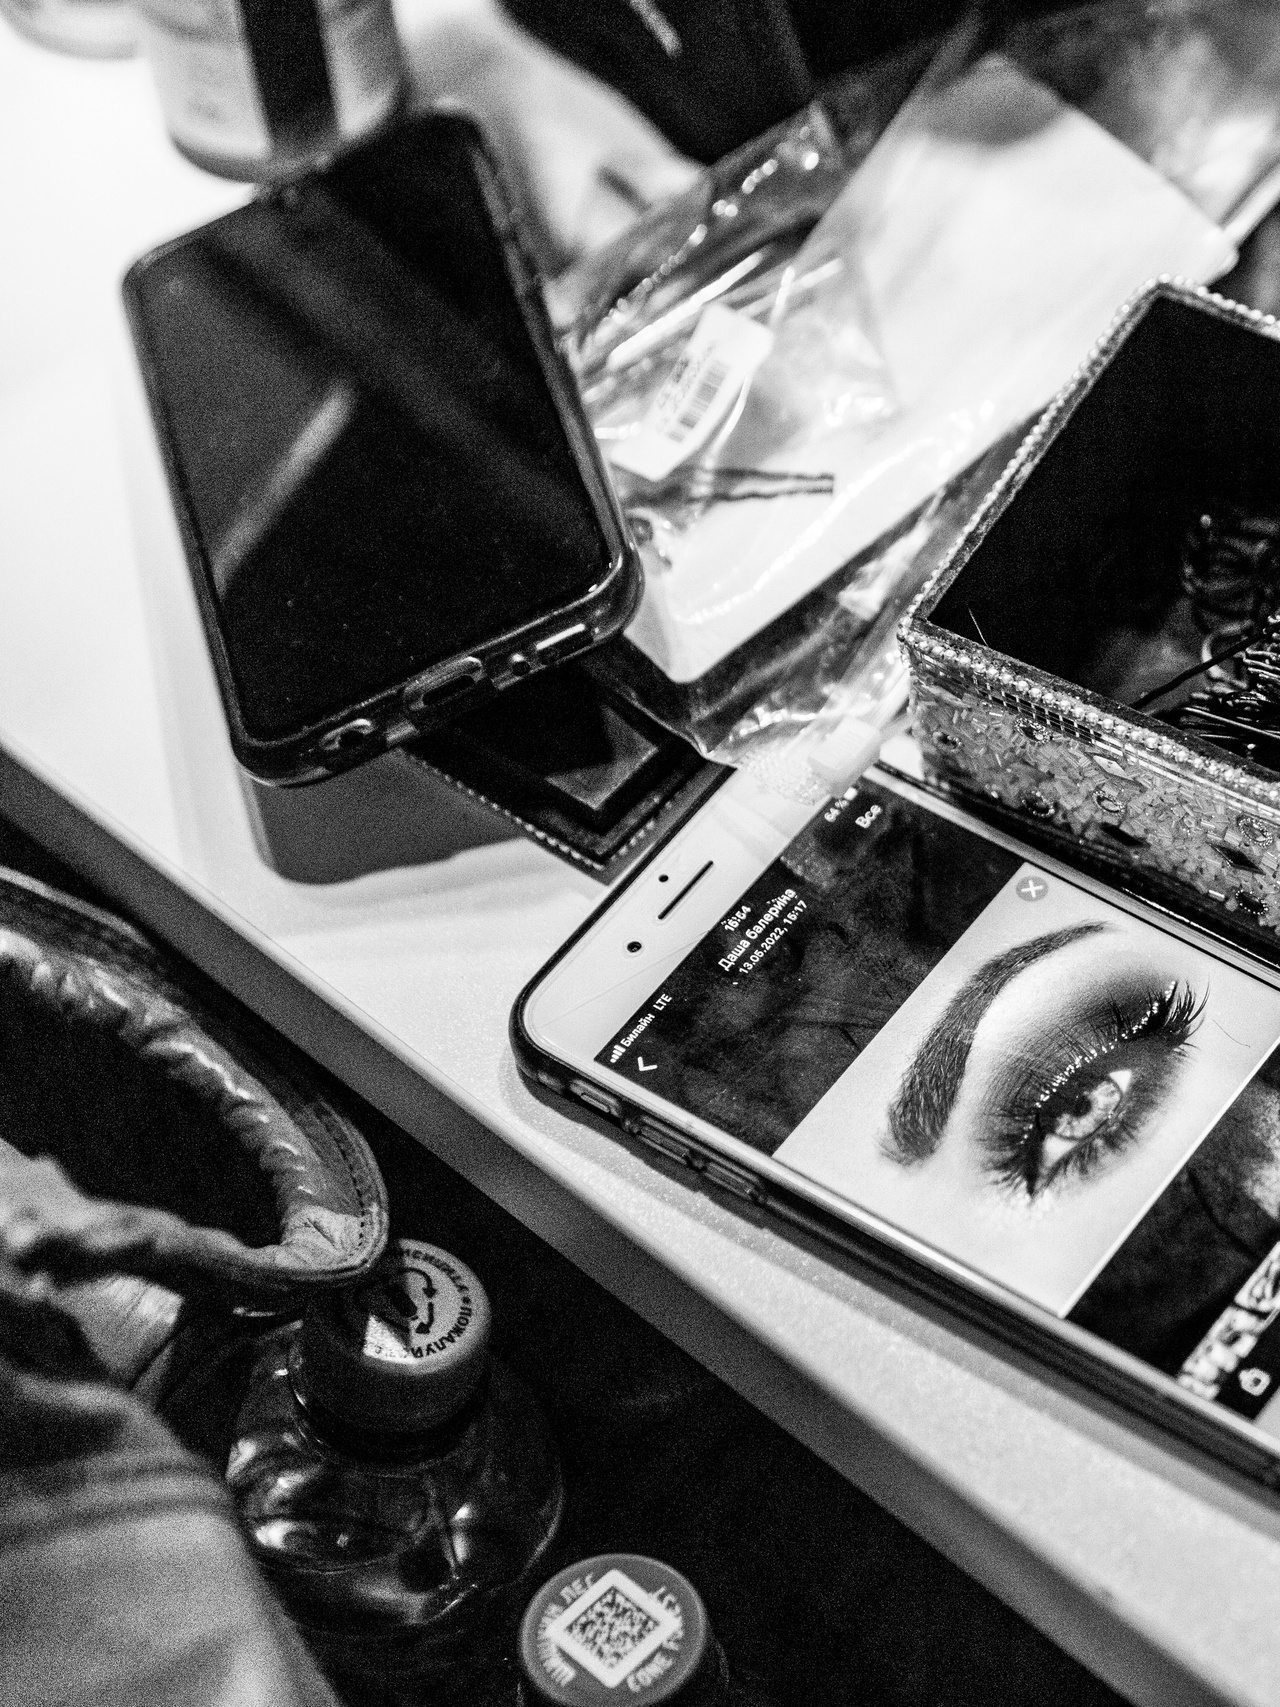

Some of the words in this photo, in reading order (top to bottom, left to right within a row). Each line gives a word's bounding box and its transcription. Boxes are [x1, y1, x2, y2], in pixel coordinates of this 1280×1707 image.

[855, 804, 882, 828] Все
[718, 938, 750, 971] Даша
[747, 887, 796, 940] балерина
[739, 926, 788, 975] 13.05.2022,
[621, 1012, 655, 1047] Билайн
[653, 993, 673, 1012] LTE
